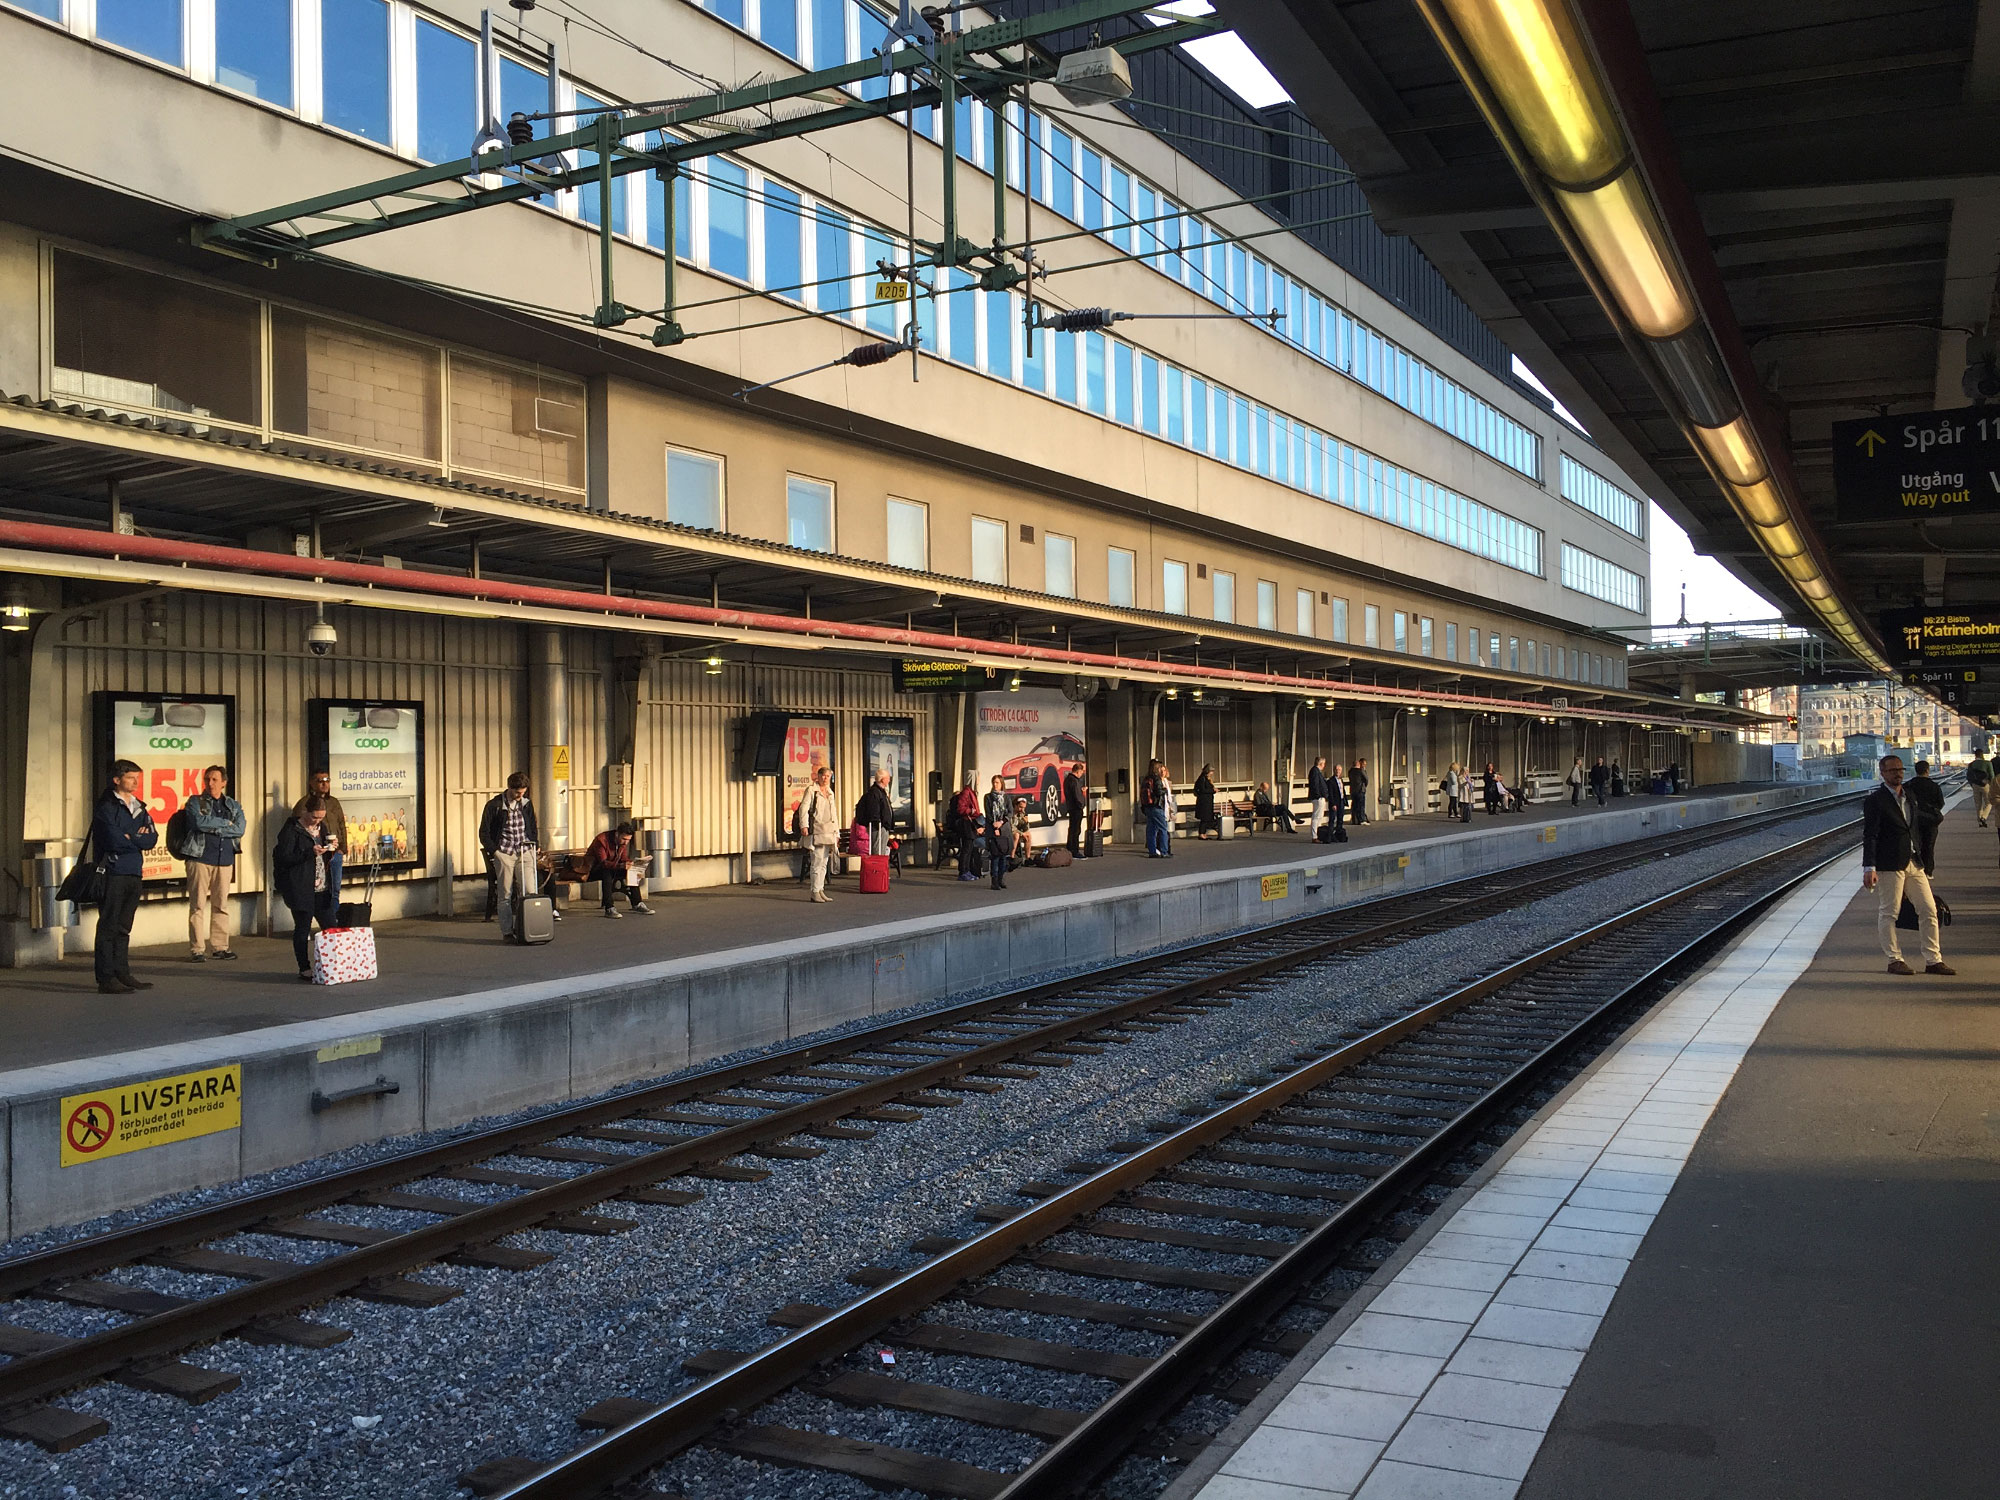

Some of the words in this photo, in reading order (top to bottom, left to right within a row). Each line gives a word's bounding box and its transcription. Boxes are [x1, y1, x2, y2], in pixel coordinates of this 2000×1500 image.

[878, 286, 905, 298] A2D5
[1903, 420, 1966, 452] Spår
[1977, 417, 2000, 440] 11
[1901, 470, 1964, 490] Utgång
[1901, 492, 1938, 508] Way
[1941, 489, 1971, 503] out
[1947, 615, 1970, 623] Bistro
[1902, 626, 1921, 635] Spår
[1905, 634, 1919, 650] 11
[902, 662, 930, 672] Skövde
[985, 667, 996, 679] 10
[1922, 672, 1941, 682] Spår
[1944, 672, 1953, 680] 11
[1948, 692, 1956, 702] B
[1553, 699, 1566, 709] 150
[980, 704, 1006, 721] CITROËN
[1007, 708, 1016, 721] C4
[1016, 709, 1040, 722] CACTUS
[149, 737, 193, 751] coop
[355, 738, 390, 750] coop
[785, 727, 810, 763] 15
[810, 727, 827, 746] KR
[339, 771, 358, 780] Idag
[359, 770, 393, 779] drabbas
[394, 770, 407, 778] ett
[787, 774, 793, 787] 9
[342, 782, 361, 791] barn
[374, 781, 403, 790] cancer.
[144, 846, 168, 856] UGGE
[120, 1073, 236, 1116] LIVSFARA
[120, 1112, 168, 1130] förbjudet
[170, 1109, 184, 1119] att
[186, 1100, 225, 1116] beträda
[120, 1118, 185, 1141] spårområdet
